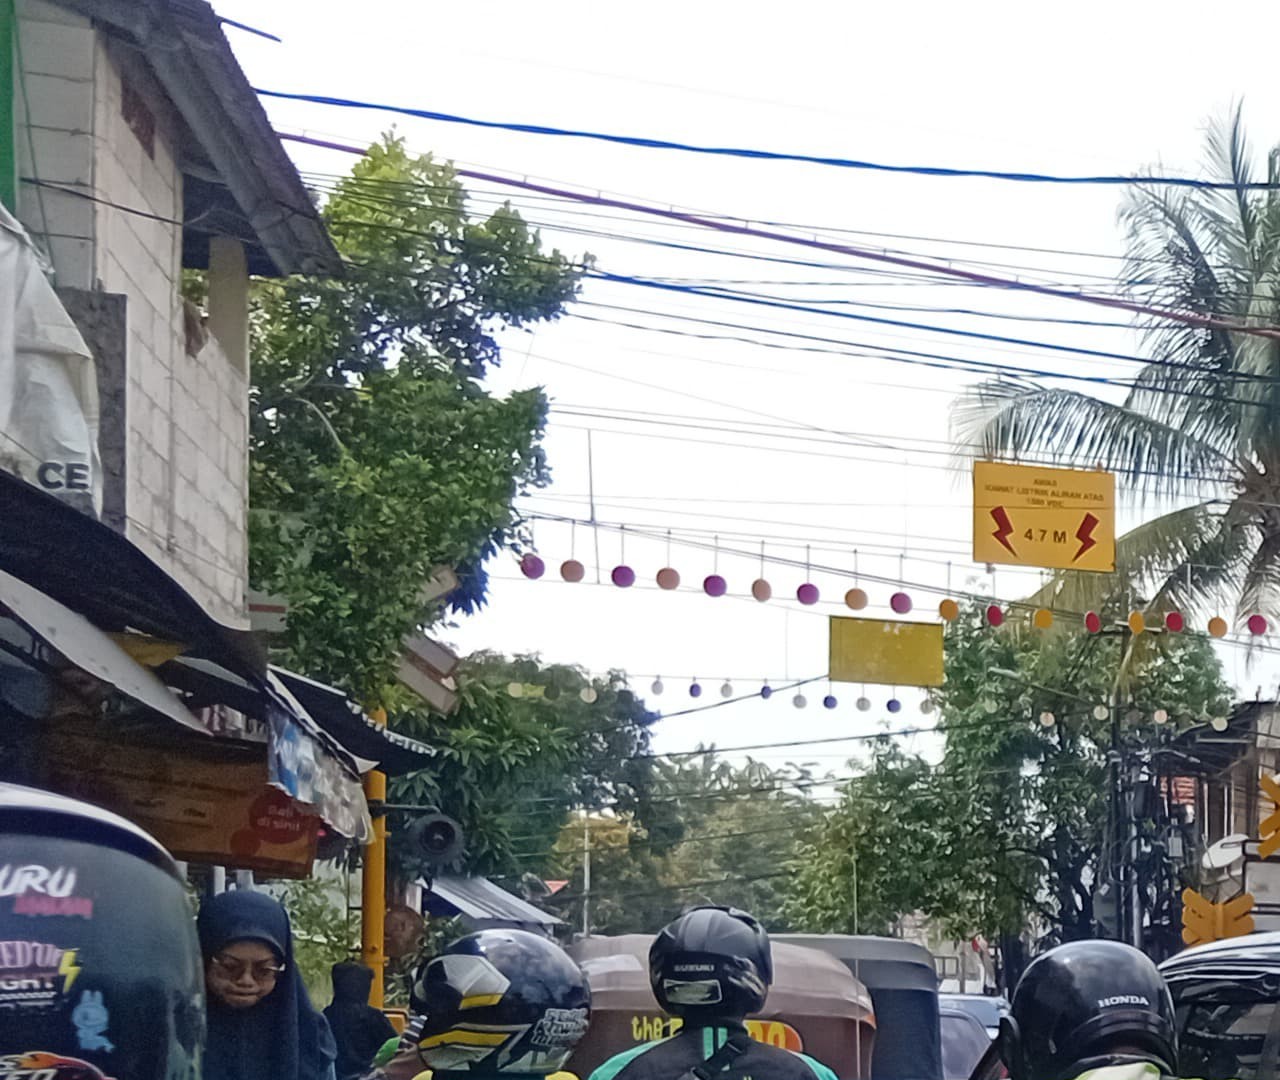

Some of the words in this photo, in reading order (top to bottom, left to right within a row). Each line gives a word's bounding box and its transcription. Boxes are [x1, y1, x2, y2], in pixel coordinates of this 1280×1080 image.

[37, 462, 89, 490] CE
[1024, 528, 1048, 542] 4.7
[1053, 530, 1067, 544] M
[1098, 995, 1149, 1008] HONDA
